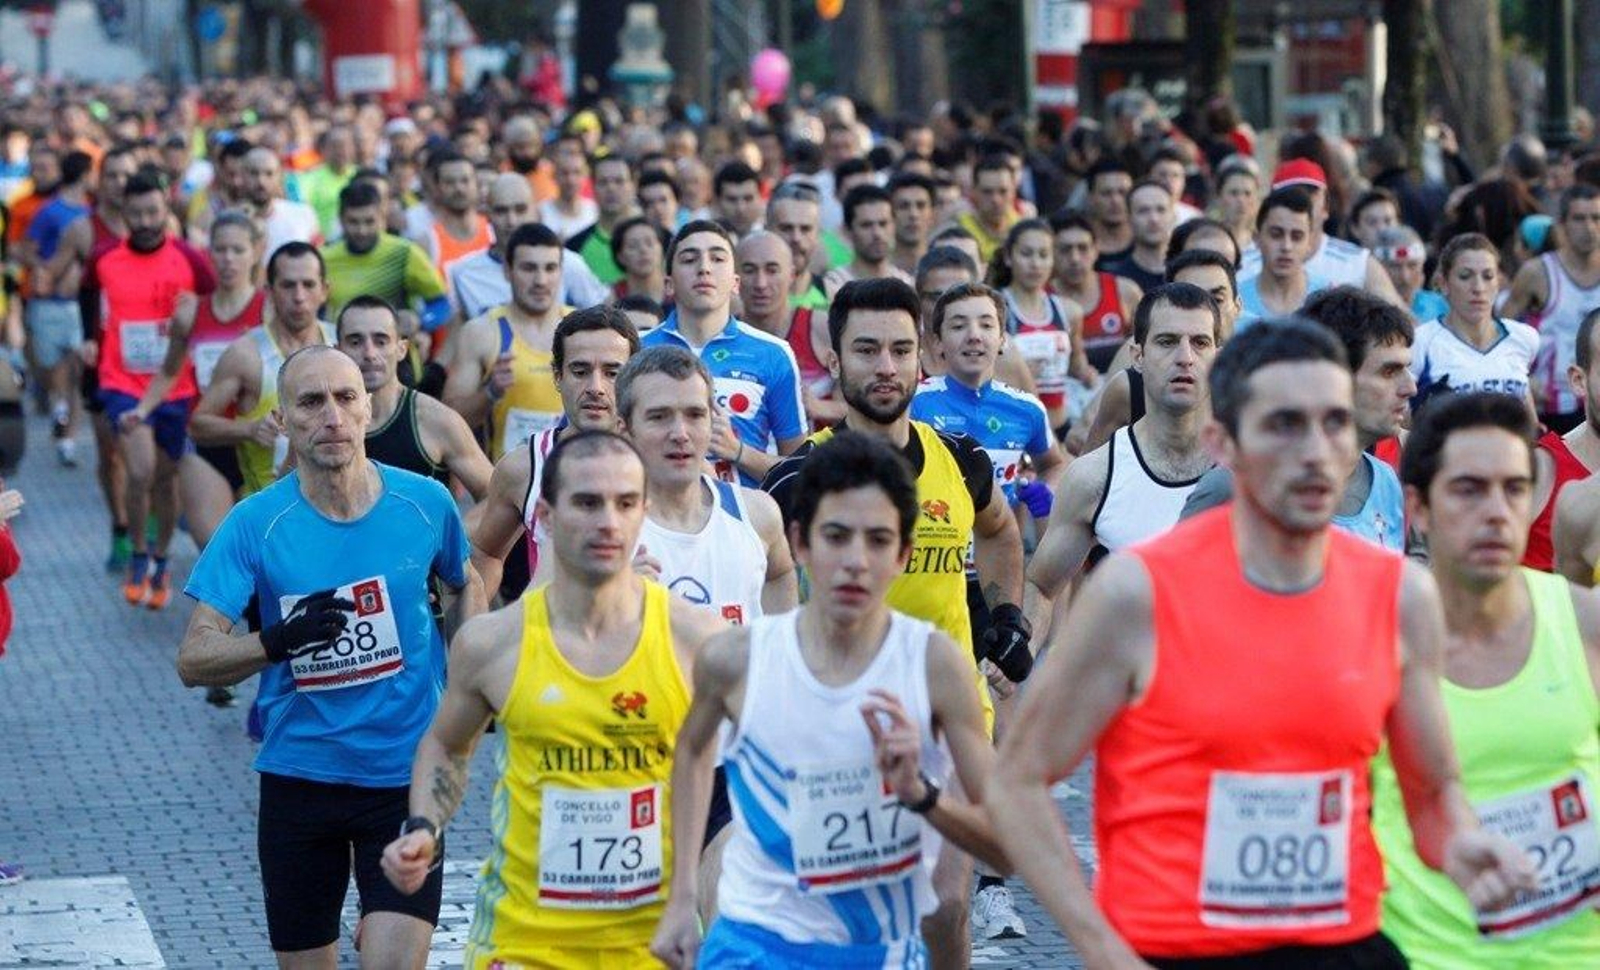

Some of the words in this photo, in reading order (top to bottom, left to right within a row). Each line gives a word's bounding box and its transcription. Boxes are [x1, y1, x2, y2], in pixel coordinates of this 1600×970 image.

[294, 663, 308, 674] 53
[309, 655, 358, 673] CARREIRA
[359, 652, 373, 663] DO
[375, 646, 399, 660] PAVO
[555, 800, 622, 812] CONCELLO
[561, 813, 576, 824] DE
[582, 813, 613, 825] VIGO
[823, 801, 902, 851] 217
[569, 835, 643, 871] 173
[1237, 832, 1330, 881] 080
